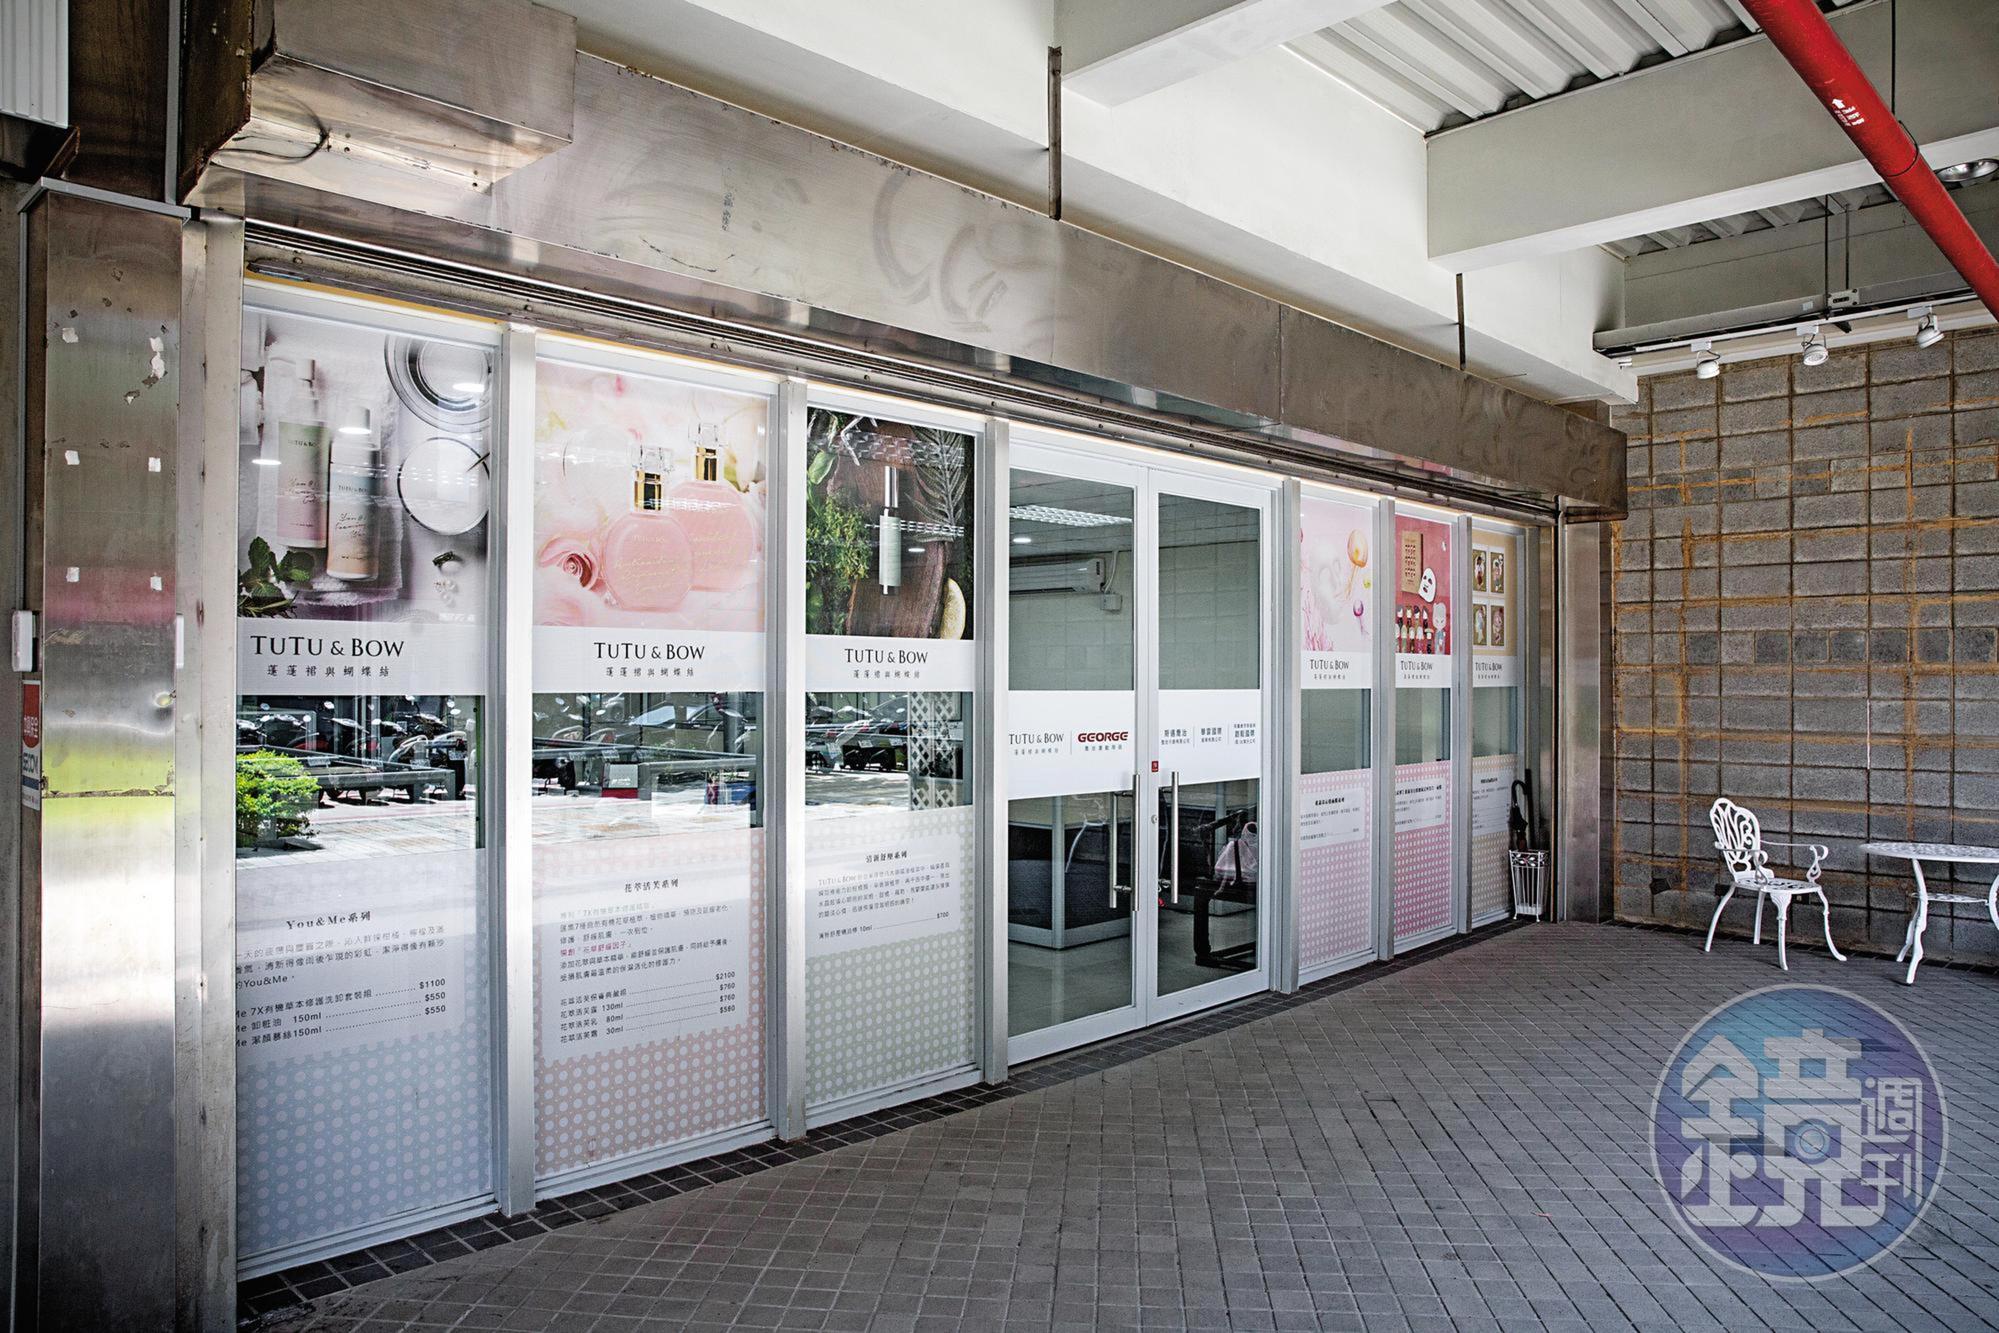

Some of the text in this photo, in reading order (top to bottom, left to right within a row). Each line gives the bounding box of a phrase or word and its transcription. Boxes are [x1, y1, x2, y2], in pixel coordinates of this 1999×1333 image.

[250, 635, 404, 657] TUTU & BOW
[594, 642, 705, 660] TUTU & BOW
[844, 648, 928, 664] TUTU & BOW
[1309, 660, 1349, 670] TUTU & BOW
[1009, 732, 1064, 745] TUTU & BOW
[1077, 732, 1129, 743] GEORGE
[715, 971, 736, 981] $2100
[419, 978, 446, 990] $1100
[293, 1012, 322, 1024] 150ml
[425, 991, 446, 1002] $550
[425, 1004, 446, 1015] $550
